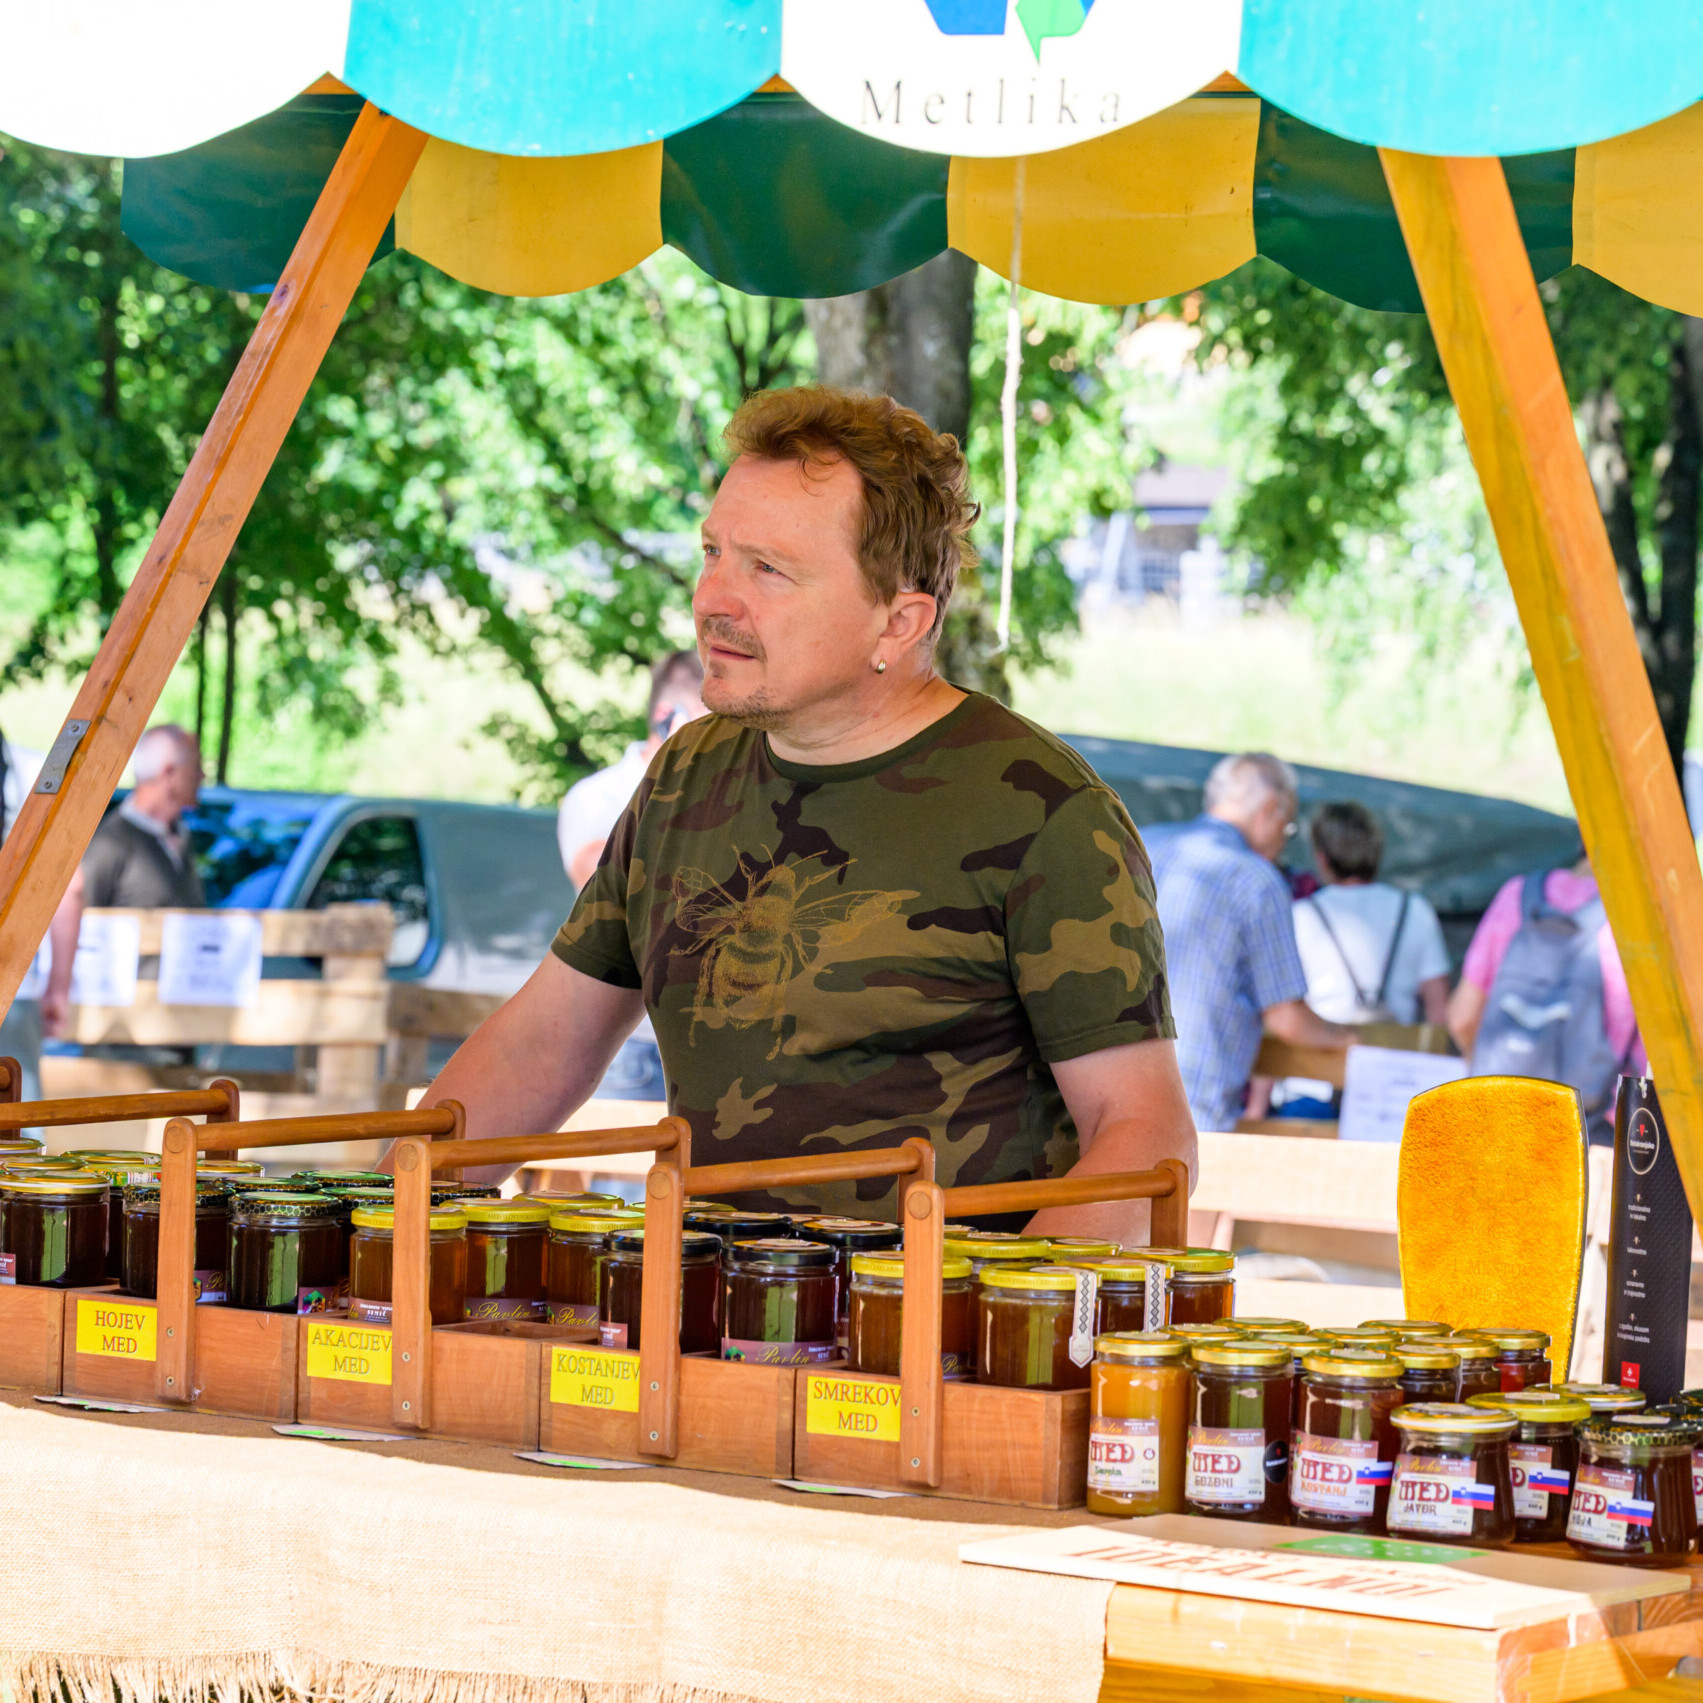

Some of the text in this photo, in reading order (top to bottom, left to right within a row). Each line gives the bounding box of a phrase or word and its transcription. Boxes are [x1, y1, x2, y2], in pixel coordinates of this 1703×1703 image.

[861, 78, 1122, 125] Metlika
[95, 1310, 146, 1331] HOJEV
[476, 1301, 530, 1320] Pavlin
[102, 1334, 138, 1354] MED
[312, 1328, 393, 1352] AKACIJEV
[333, 1355, 371, 1375] MED
[755, 1345, 810, 1364] Pavlin
[556, 1353, 641, 1381] KOSTANJEV
[581, 1384, 615, 1406] MED
[813, 1380, 901, 1407] SMREKOV
[837, 1410, 878, 1433] MED
[1090, 1440, 1135, 1464] MED
[1192, 1451, 1241, 1474] MED
[1300, 1457, 1353, 1484] MED
[1398, 1480, 1450, 1503] MED
